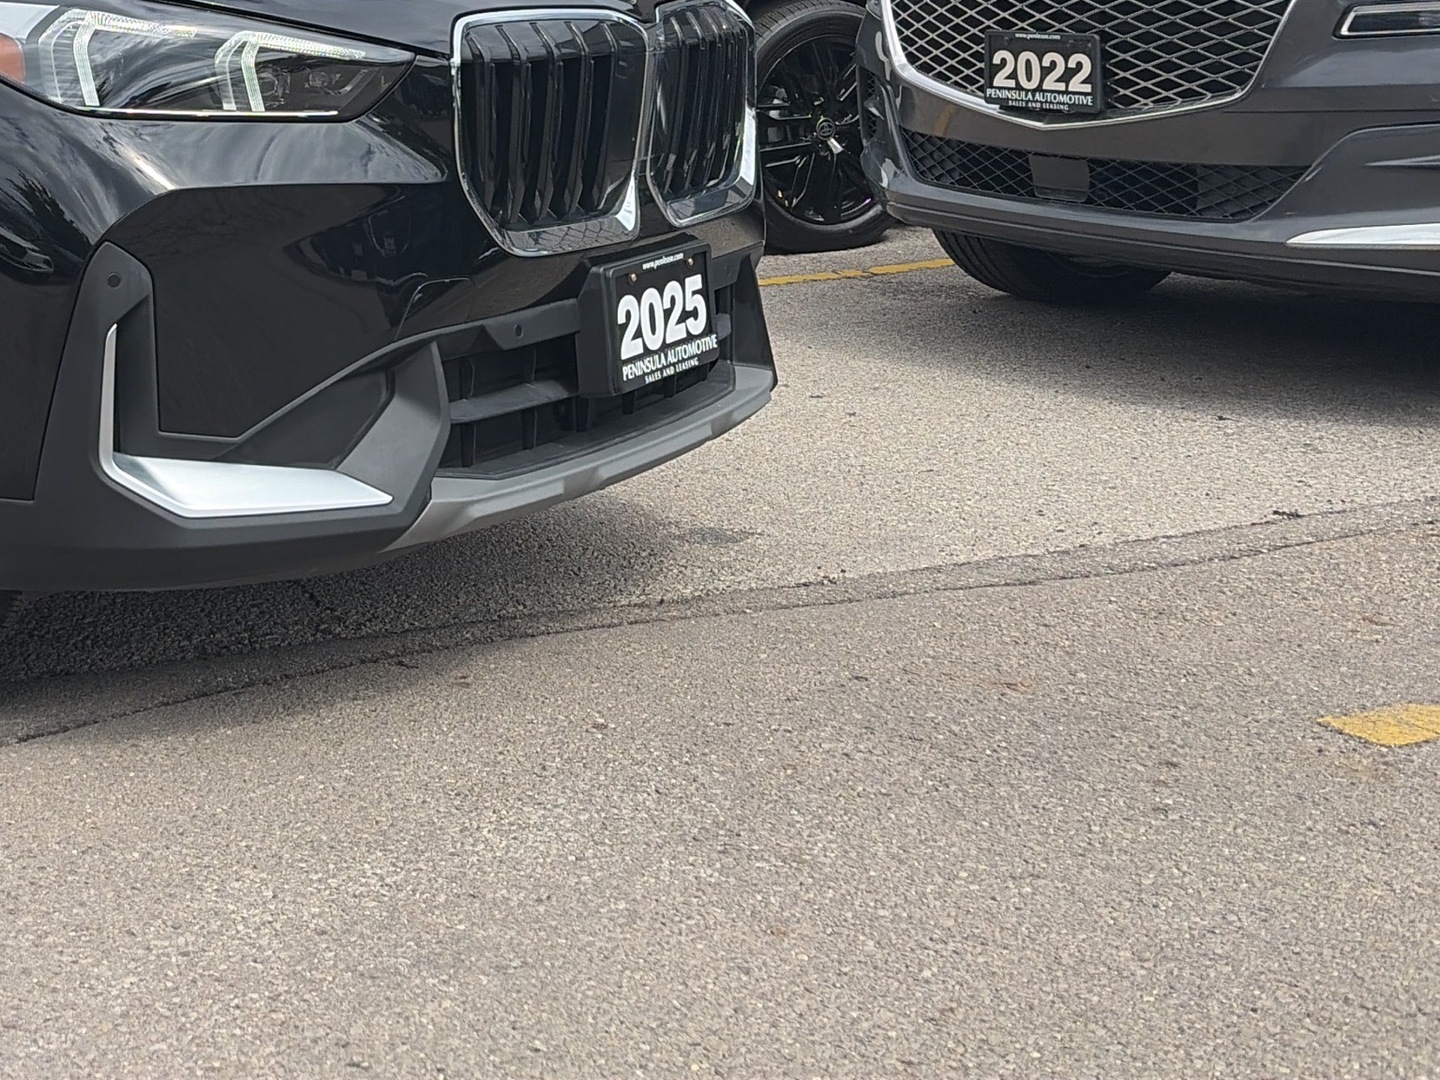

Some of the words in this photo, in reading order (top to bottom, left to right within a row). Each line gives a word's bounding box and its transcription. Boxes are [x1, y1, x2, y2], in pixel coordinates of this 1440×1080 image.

[992, 49, 1092, 93] 2022
[986, 88, 1033, 101] PENINSULA
[1034, 92, 1093, 106] AUTOMOTIVE
[617, 273, 707, 361] 2025
[622, 352, 667, 381] PENINSULA
[667, 334, 718, 365] AUTOMOTIVE
[645, 370, 662, 384] SALES
[663, 366, 675, 377] AND
[675, 357, 699, 372] LEASING
